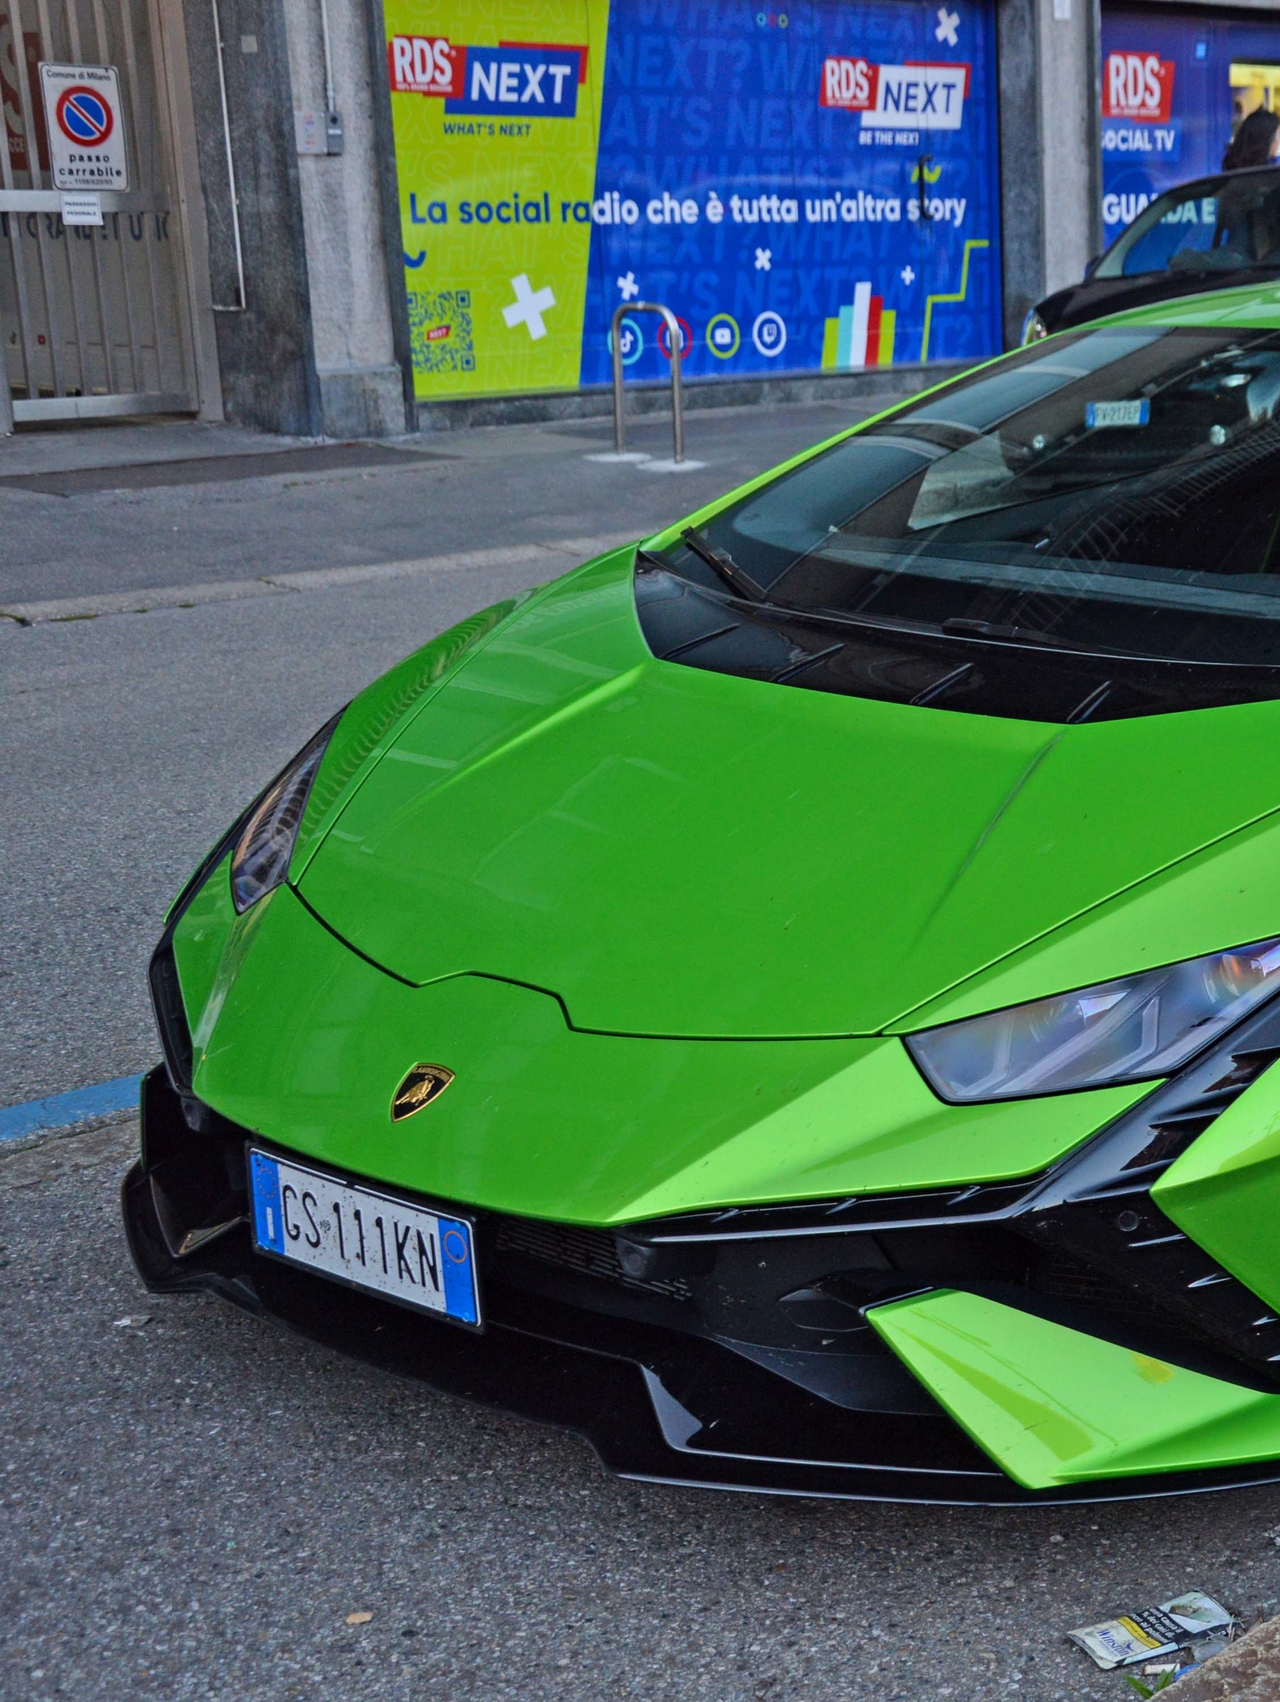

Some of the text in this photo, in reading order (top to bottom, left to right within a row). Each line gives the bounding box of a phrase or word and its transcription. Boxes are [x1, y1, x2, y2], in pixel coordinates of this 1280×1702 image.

[46, 69, 111, 82] Comune di Milano
[393, 36, 572, 104] RDS NEXT
[1109, 54, 1161, 108] RDS
[825, 58, 869, 101] RDS
[883, 80, 957, 114] NEXT
[444, 122, 532, 137] WHAT'S NEXT
[859, 131, 873, 145] BE
[874, 131, 893, 145] THE
[1154, 129, 1175, 151] TV
[69, 154, 110, 164] passo
[59, 167, 122, 177] carrabile
[409, 191, 448, 225] La
[458, 191, 550, 225] social
[561, 190, 640, 225] radio
[646, 190, 699, 225] che
[705, 190, 725, 224] è
[730, 193, 799, 223] tutta
[805, 190, 901, 223] un'altra
[1102, 193, 1198, 224] GUADA
[1096, 1629, 1130, 1657] Winston
